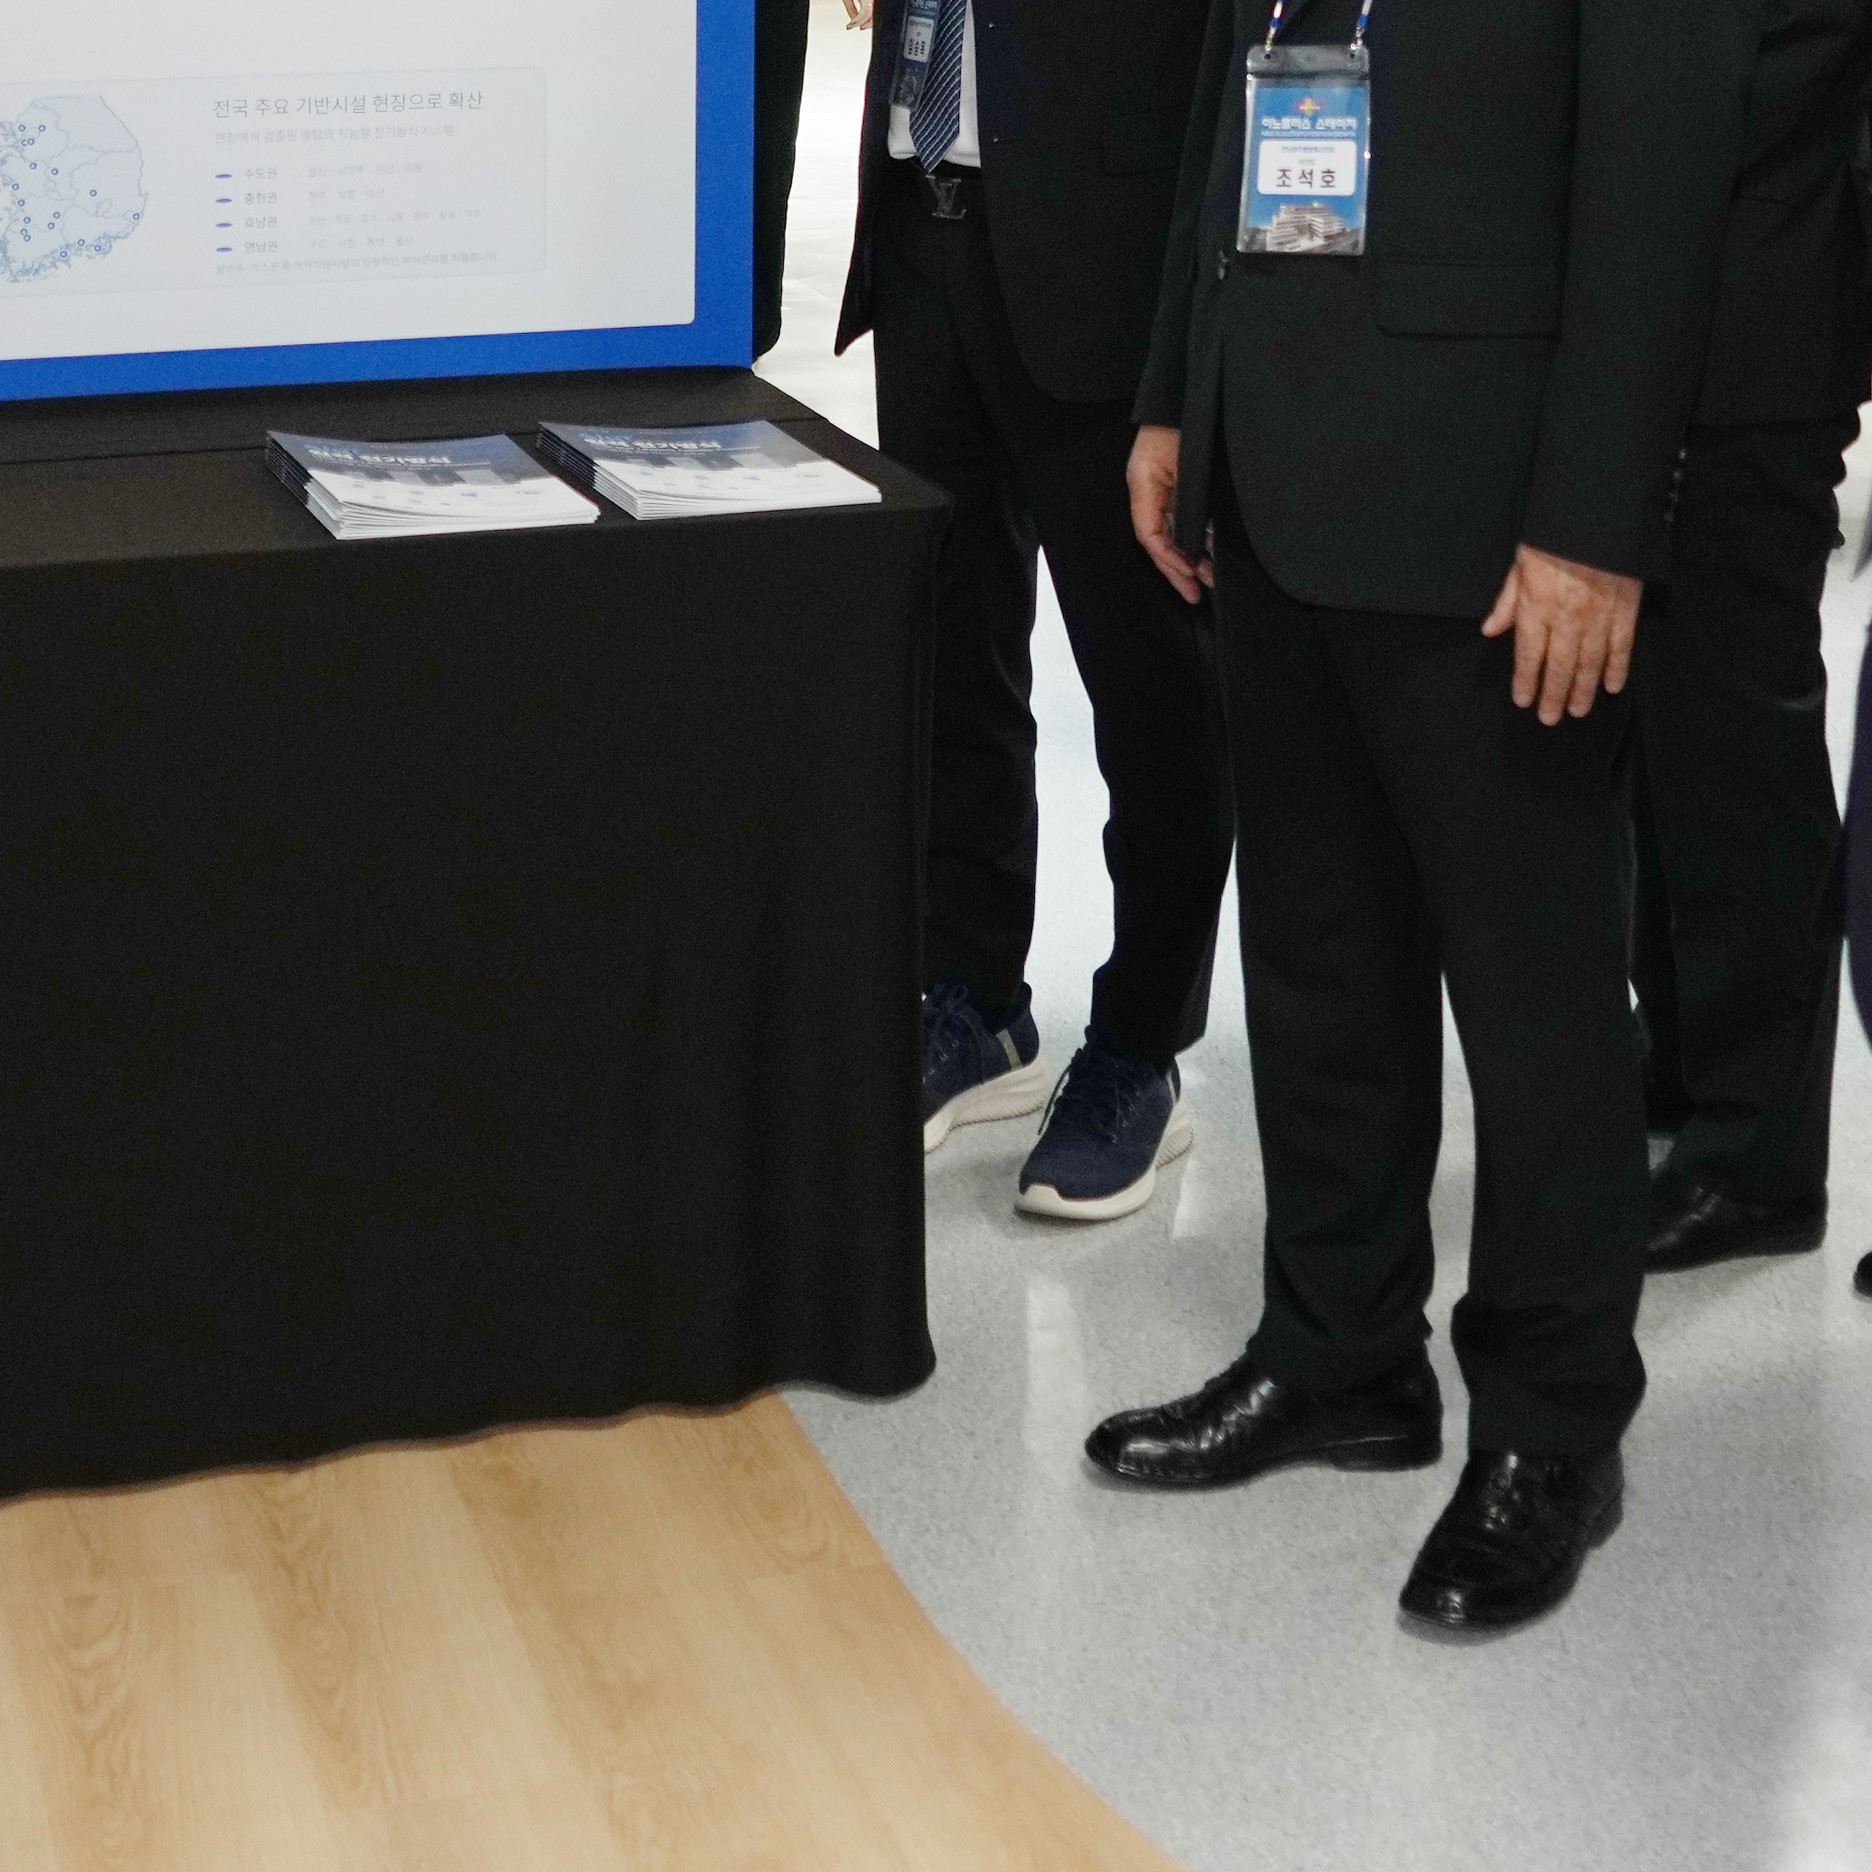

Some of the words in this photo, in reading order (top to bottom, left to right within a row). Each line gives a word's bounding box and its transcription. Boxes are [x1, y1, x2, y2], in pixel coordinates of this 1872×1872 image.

[213, 99, 249, 118] 전국
[255, 98, 289, 116] 주요
[296, 95, 367, 115] 기반시설
[372, 93, 442, 113] 현장으로
[448, 91, 483, 111] 확산
